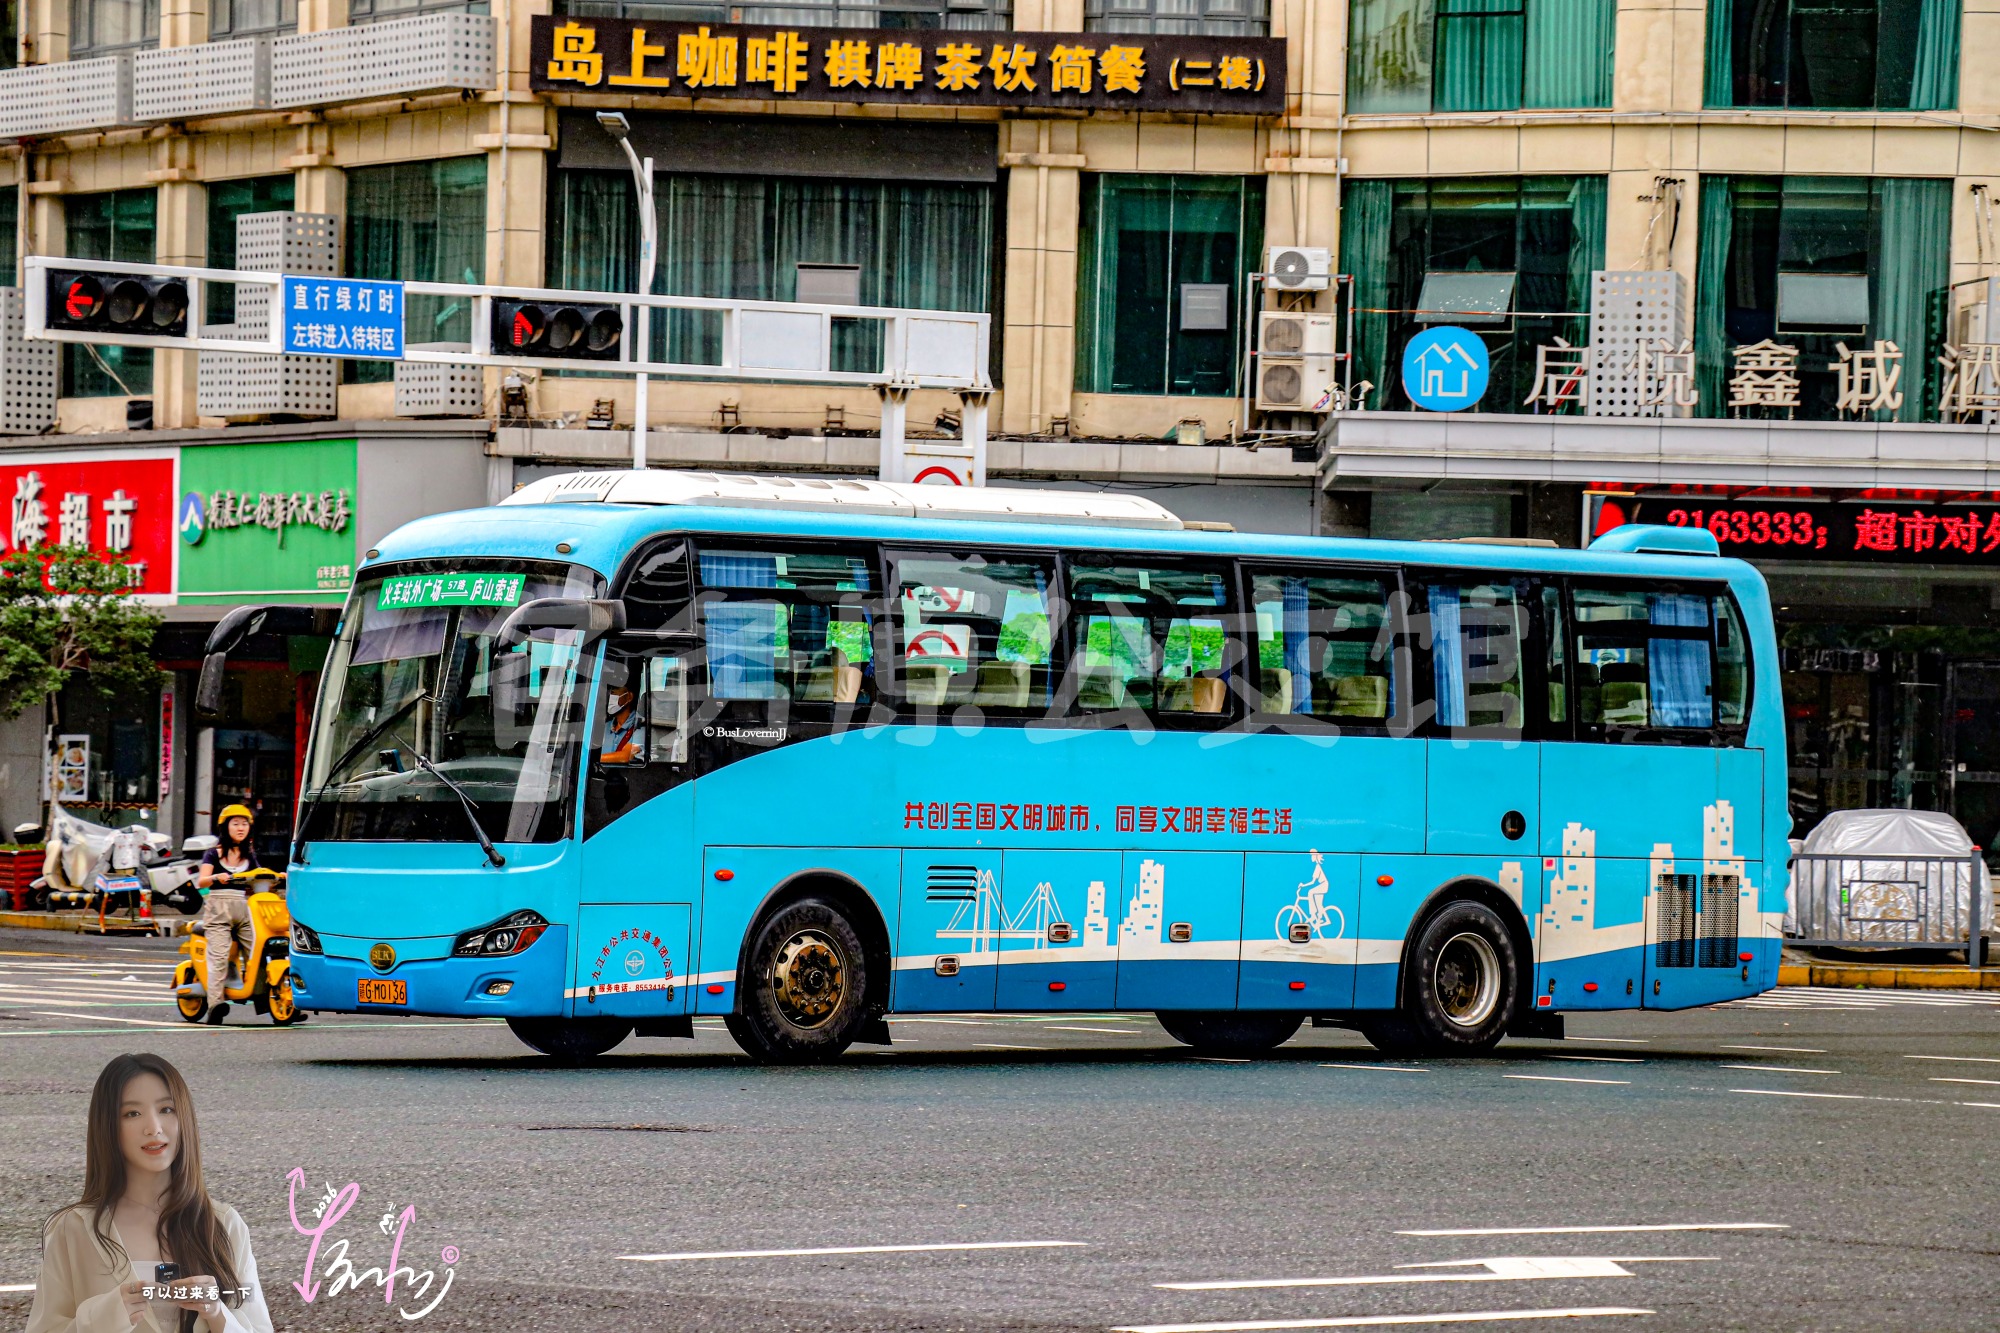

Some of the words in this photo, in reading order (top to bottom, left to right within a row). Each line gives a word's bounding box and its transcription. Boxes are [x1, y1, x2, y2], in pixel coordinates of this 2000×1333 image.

[293, 284, 395, 314] 直行绿灯时
[292, 322, 396, 352] 左转进入待转区
[381, 579, 441, 606] 火车站外广场
[447, 580, 466, 590] 57路
[469, 578, 519, 602] 庐山索道
[591, 928, 674, 981] 九江市公共交通集团公司
